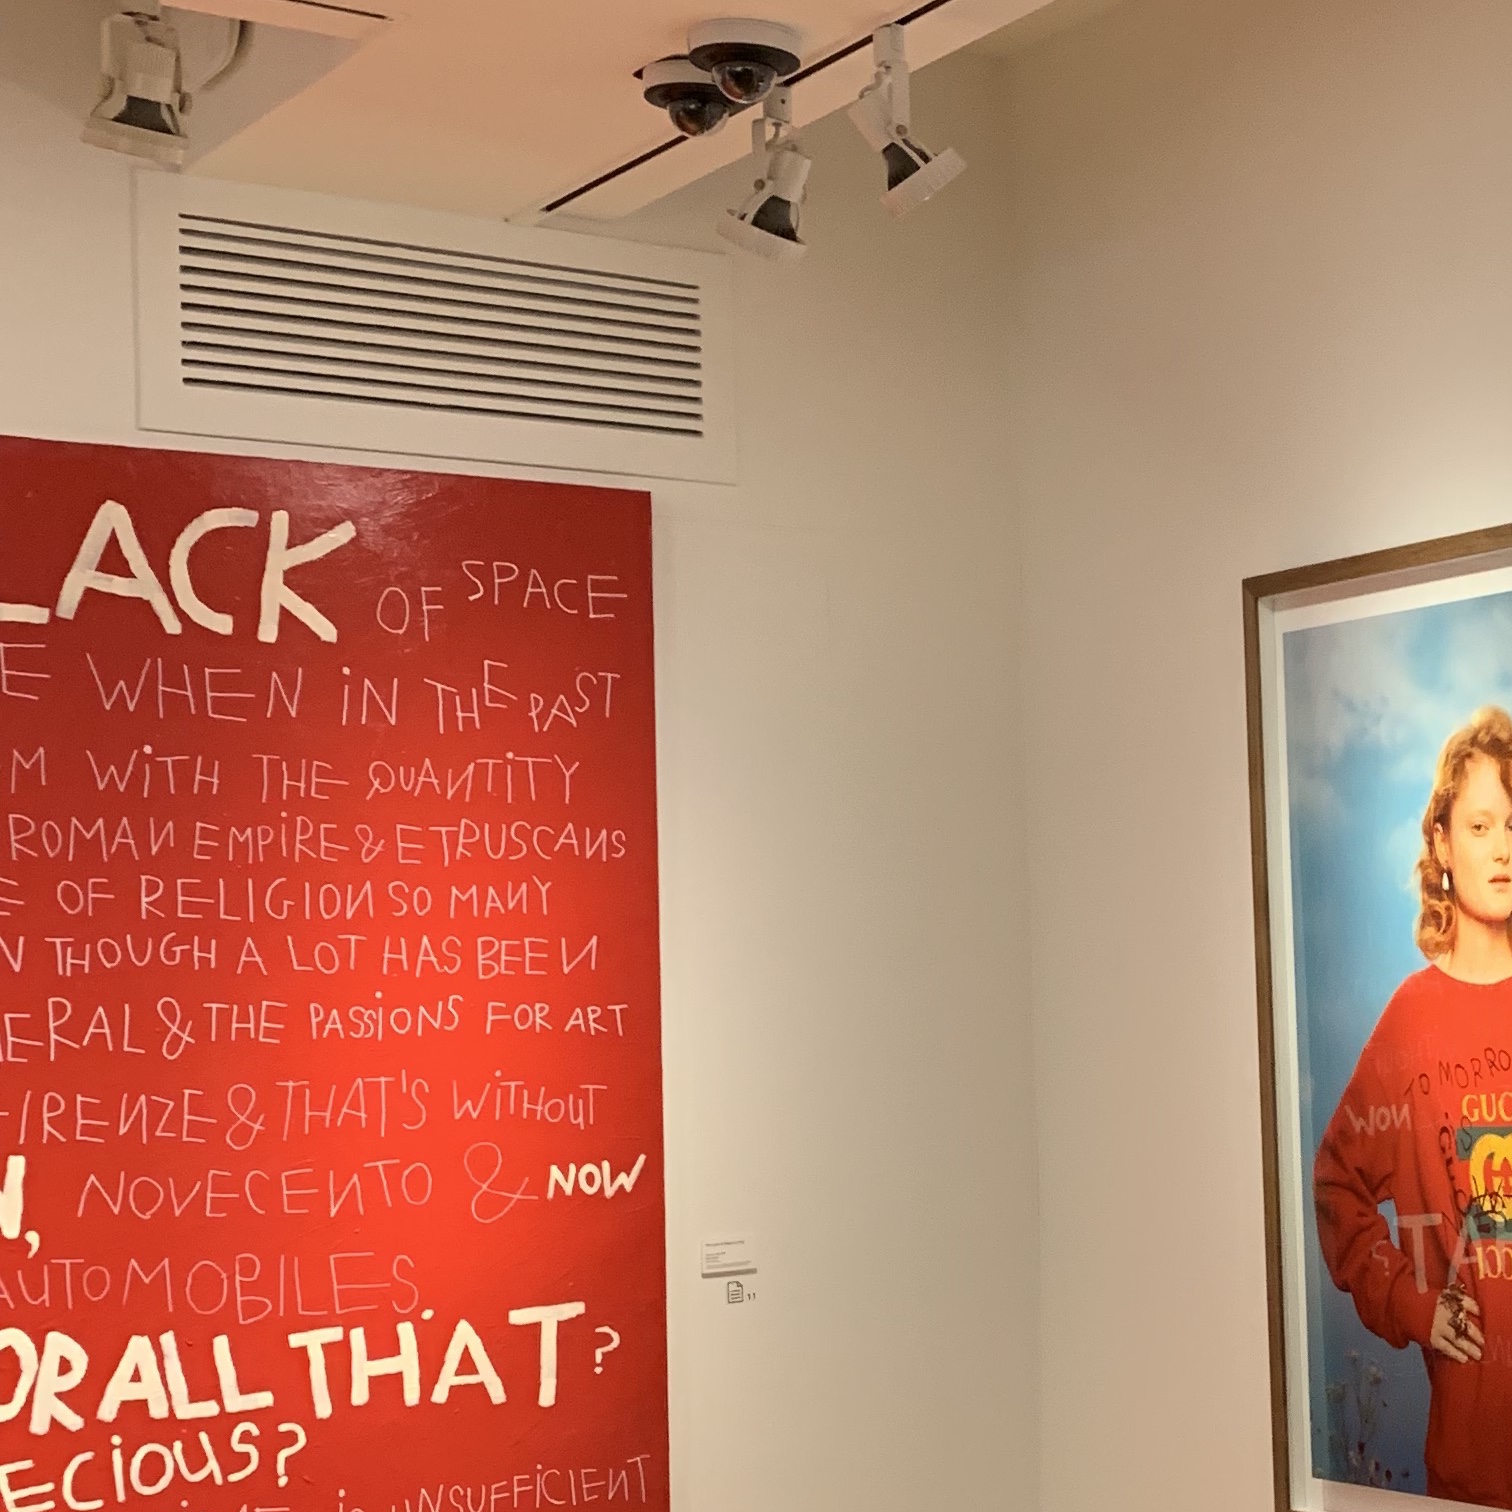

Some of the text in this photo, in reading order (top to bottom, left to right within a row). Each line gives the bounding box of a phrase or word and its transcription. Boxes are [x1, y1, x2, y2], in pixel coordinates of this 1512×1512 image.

[376, 585, 444, 642] OF
[461, 560, 628, 618] SPACE
[86, 653, 302, 722] WHEN
[424, 659, 518, 734] THE
[528, 672, 621, 732] PAST
[251, 754, 350, 803] THE
[8, 814, 174, 862] ROMAN
[354, 824, 385, 863] &
[396, 818, 626, 867] ETRUSCANS
[57, 878, 115, 916] OF
[140, 875, 374, 923] RELIGION
[388, 881, 432, 916] SO
[450, 875, 552, 919] MANY
[44, 932, 216, 977] THOUGH
[236, 937, 268, 975] A
[287, 934, 367, 974] LOT
[382, 935, 462, 978] HAS
[477, 935, 598, 980] BEEN
[0, 997, 145, 1062] ERAL
[157, 997, 195, 1060] &
[203, 1000, 288, 1044] THE
[486, 1001, 552, 1035] FOR
[564, 1004, 629, 1036] ART
[0, 1089, 217, 1145] IRENZE
[225, 1083, 265, 1150] &
[275, 1069, 429, 1141] THAT'S
[77, 1159, 432, 1220] NOVECENTO
[464, 1142, 539, 1223] &
[547, 1153, 647, 1201] NOW
[96, 1330, 275, 1422] ALL
